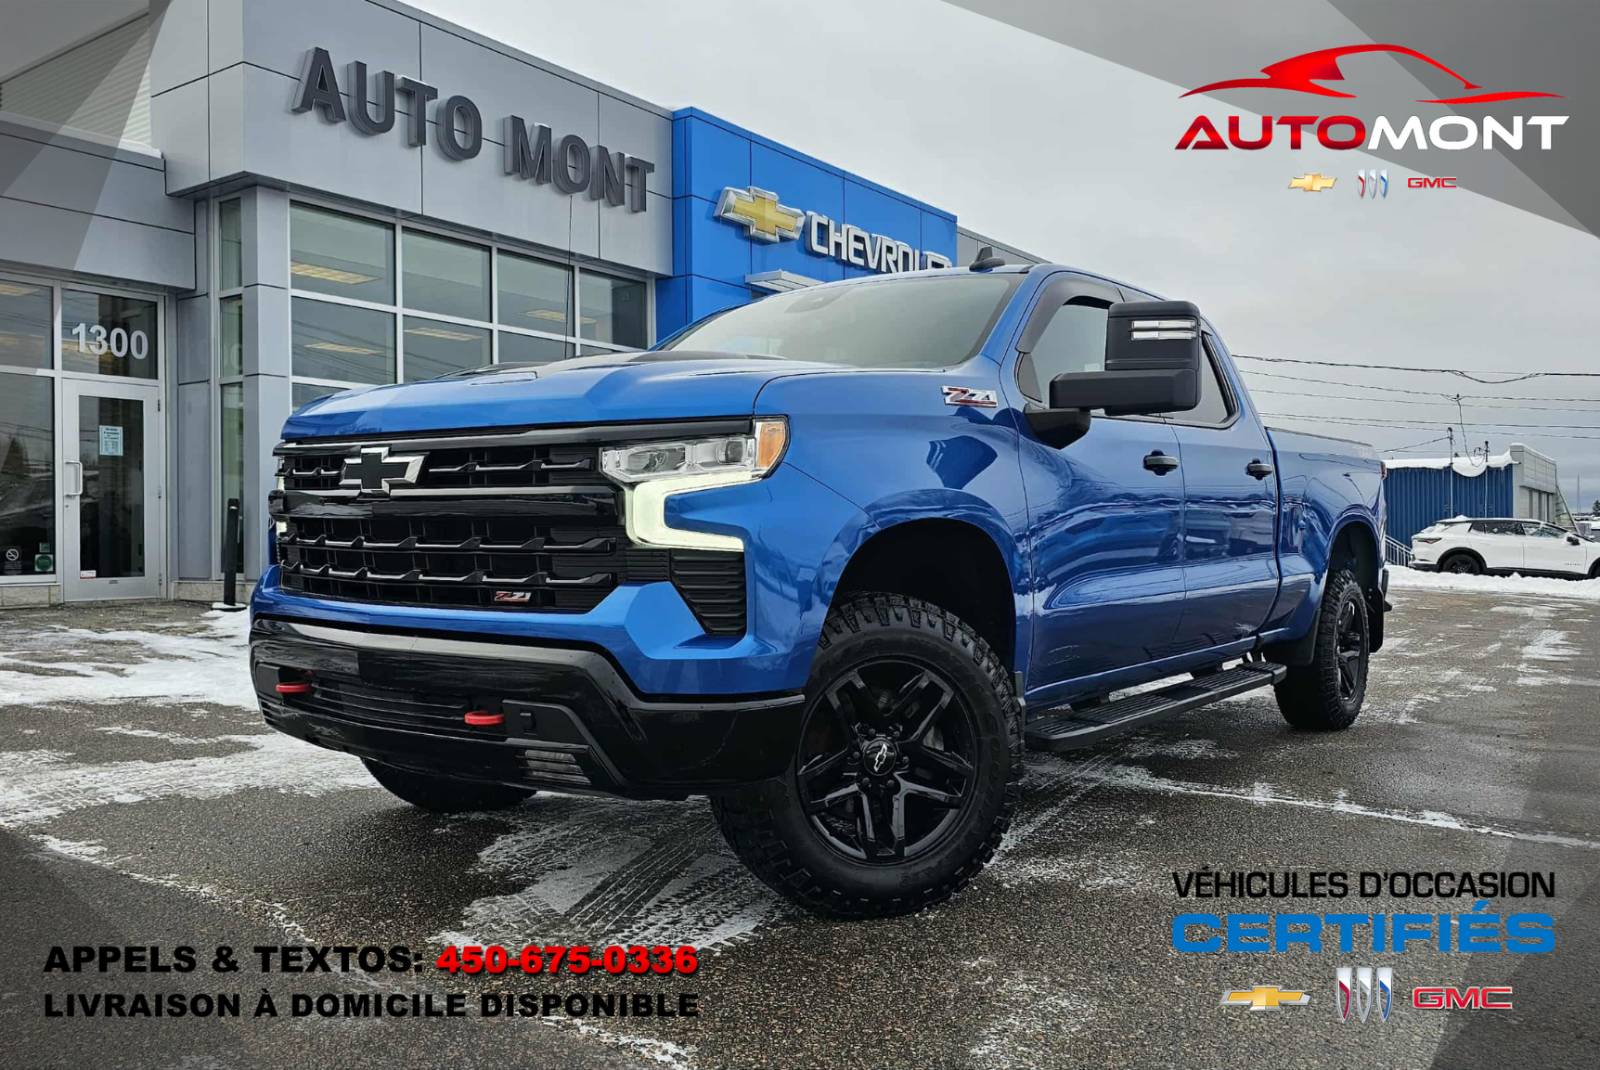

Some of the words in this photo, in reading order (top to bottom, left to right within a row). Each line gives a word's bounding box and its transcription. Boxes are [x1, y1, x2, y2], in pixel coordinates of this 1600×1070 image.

[291, 46, 482, 161] AUTO
[502, 114, 654, 213] MONT
[805, 211, 953, 273] CHEVRO
[72, 323, 148, 359] 1300
